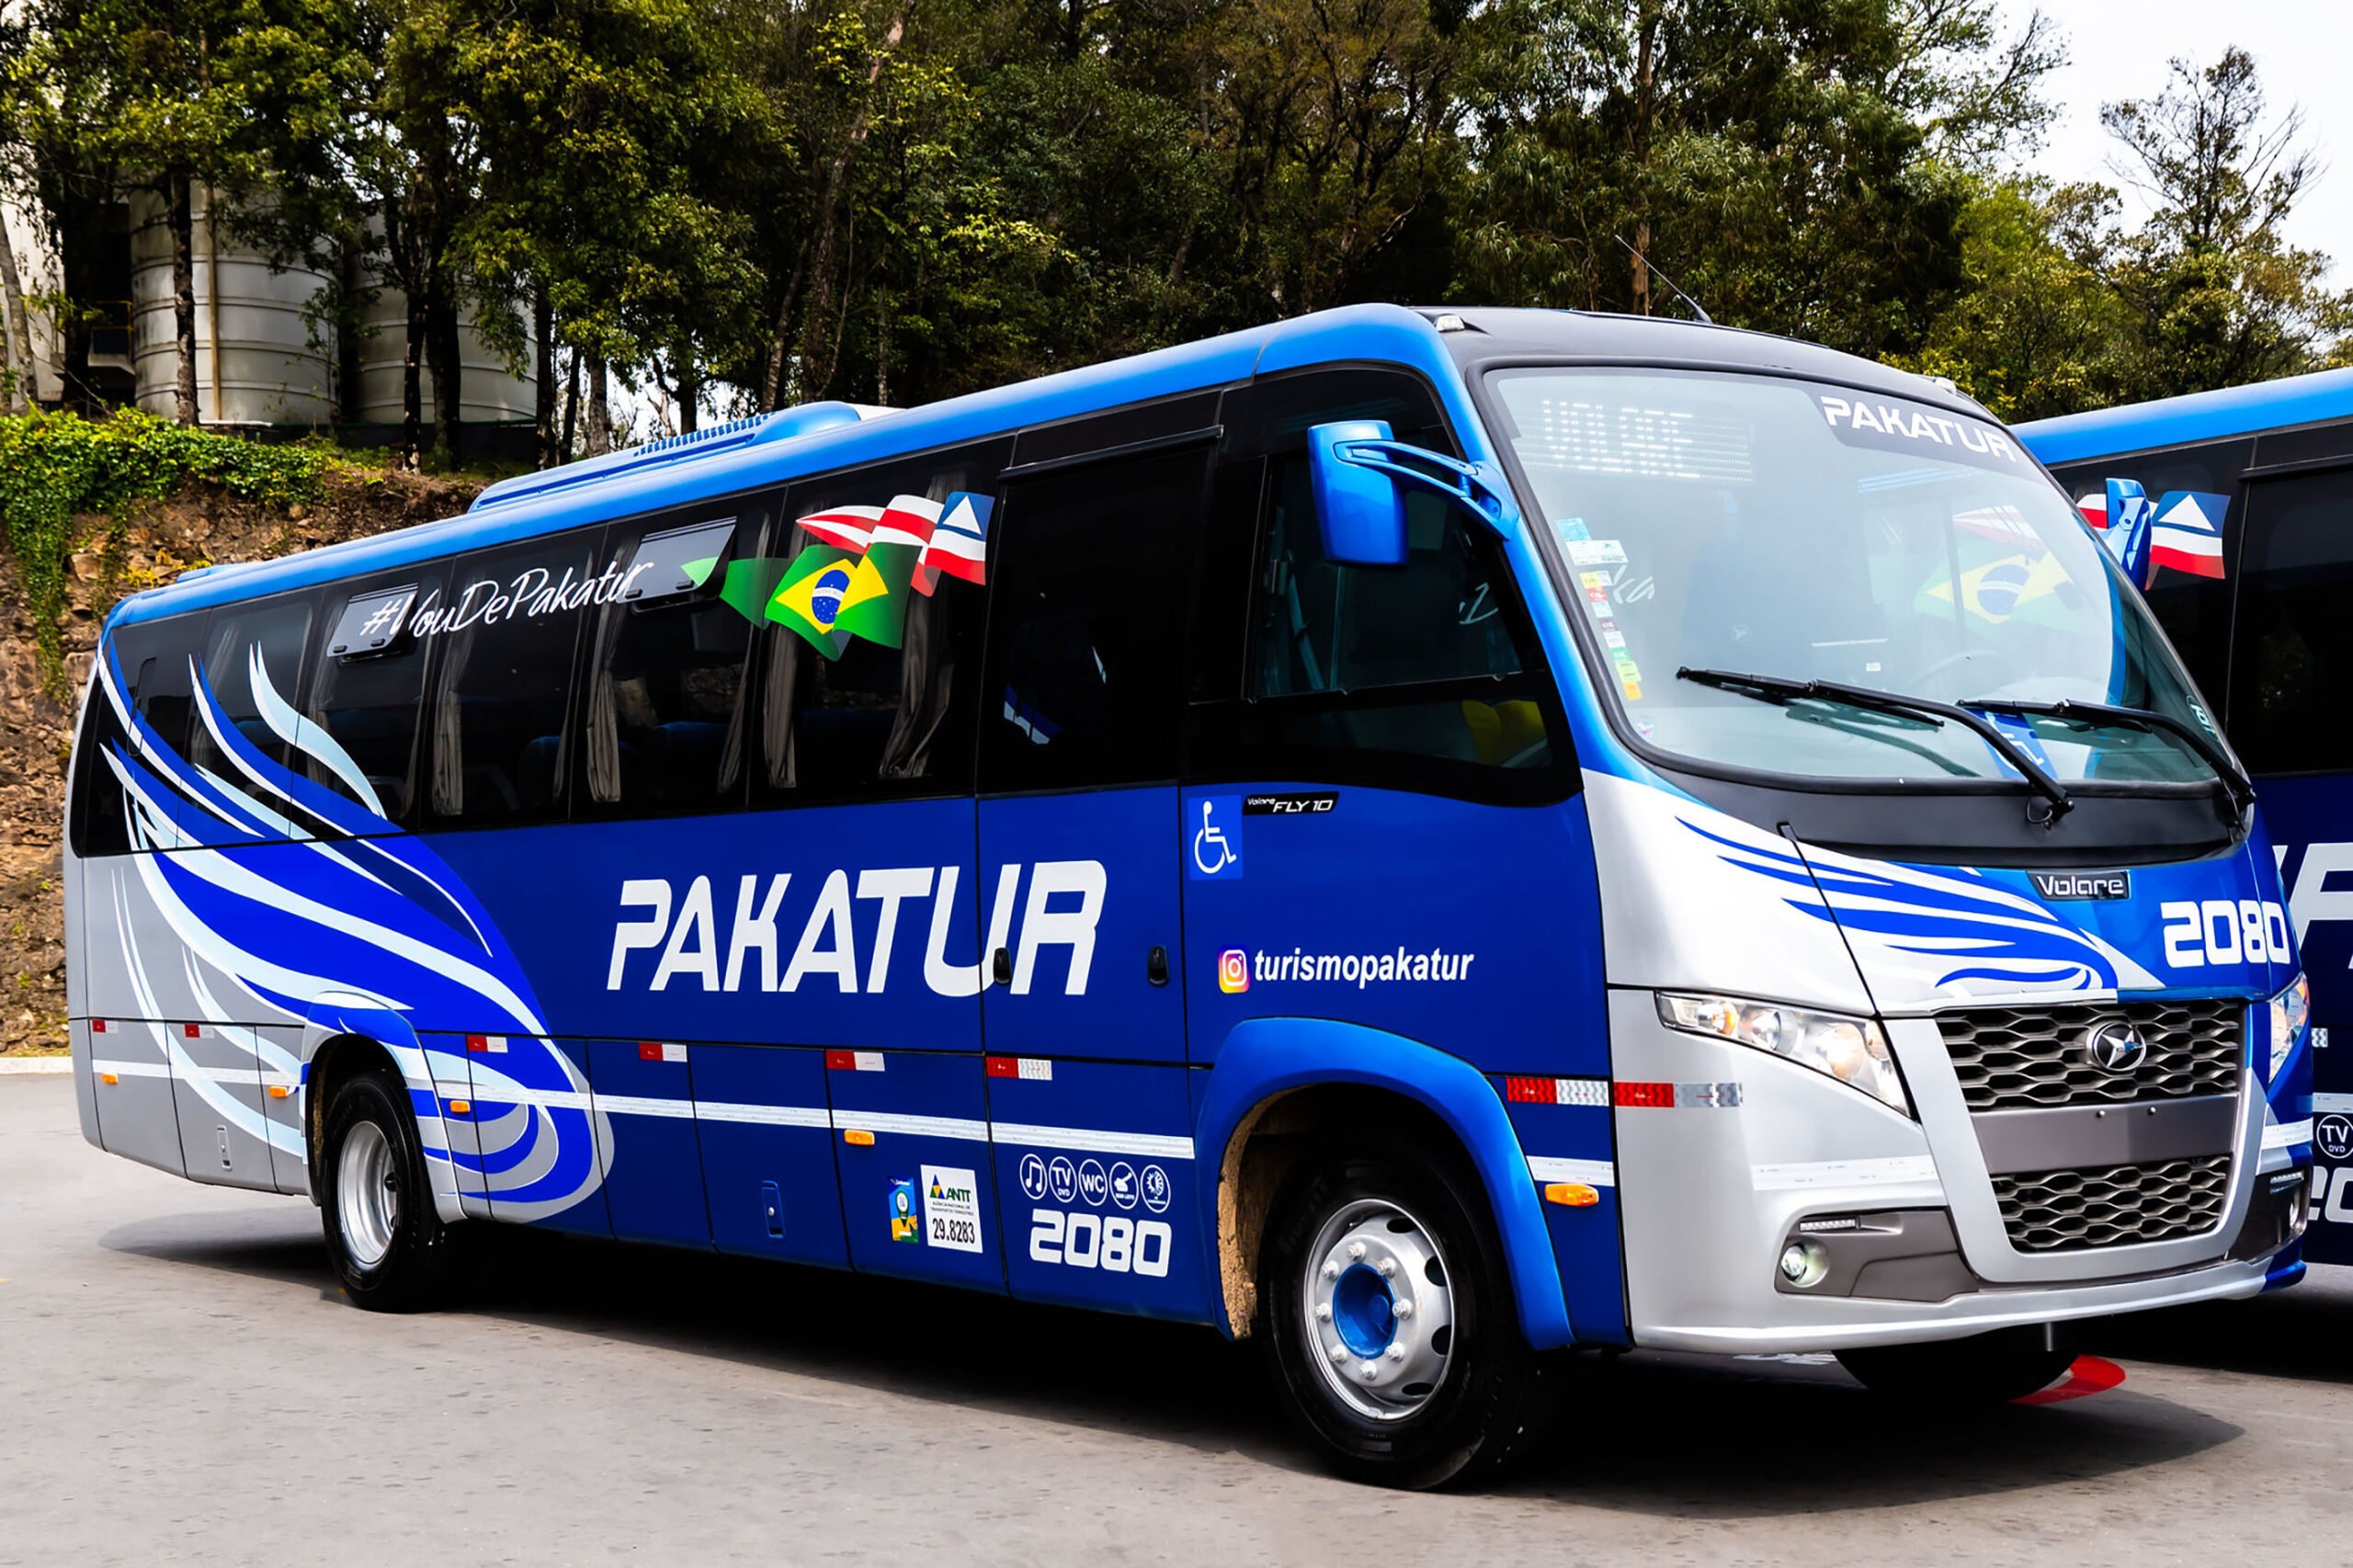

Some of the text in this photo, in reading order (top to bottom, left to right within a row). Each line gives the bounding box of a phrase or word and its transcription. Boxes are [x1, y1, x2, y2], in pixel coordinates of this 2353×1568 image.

[1820, 395, 2017, 463] PAKATUR
[1272, 801, 1310, 812] FLY
[1313, 800, 1334, 812] 10
[2037, 876, 2124, 895] Volare
[607, 859, 1107, 997] PAKATUR
[2160, 899, 2290, 968] 2080
[1255, 946, 1474, 990] turismopakatur
[2322, 1125, 2349, 1143] TV
[2328, 1145, 2346, 1153] DVD
[1052, 1166, 1072, 1187] TV
[1082, 1174, 1105, 1194] WC
[946, 1187, 972, 1203] ANTT
[932, 1217, 975, 1244] 29.8283
[1029, 1209, 1172, 1278] 2080
